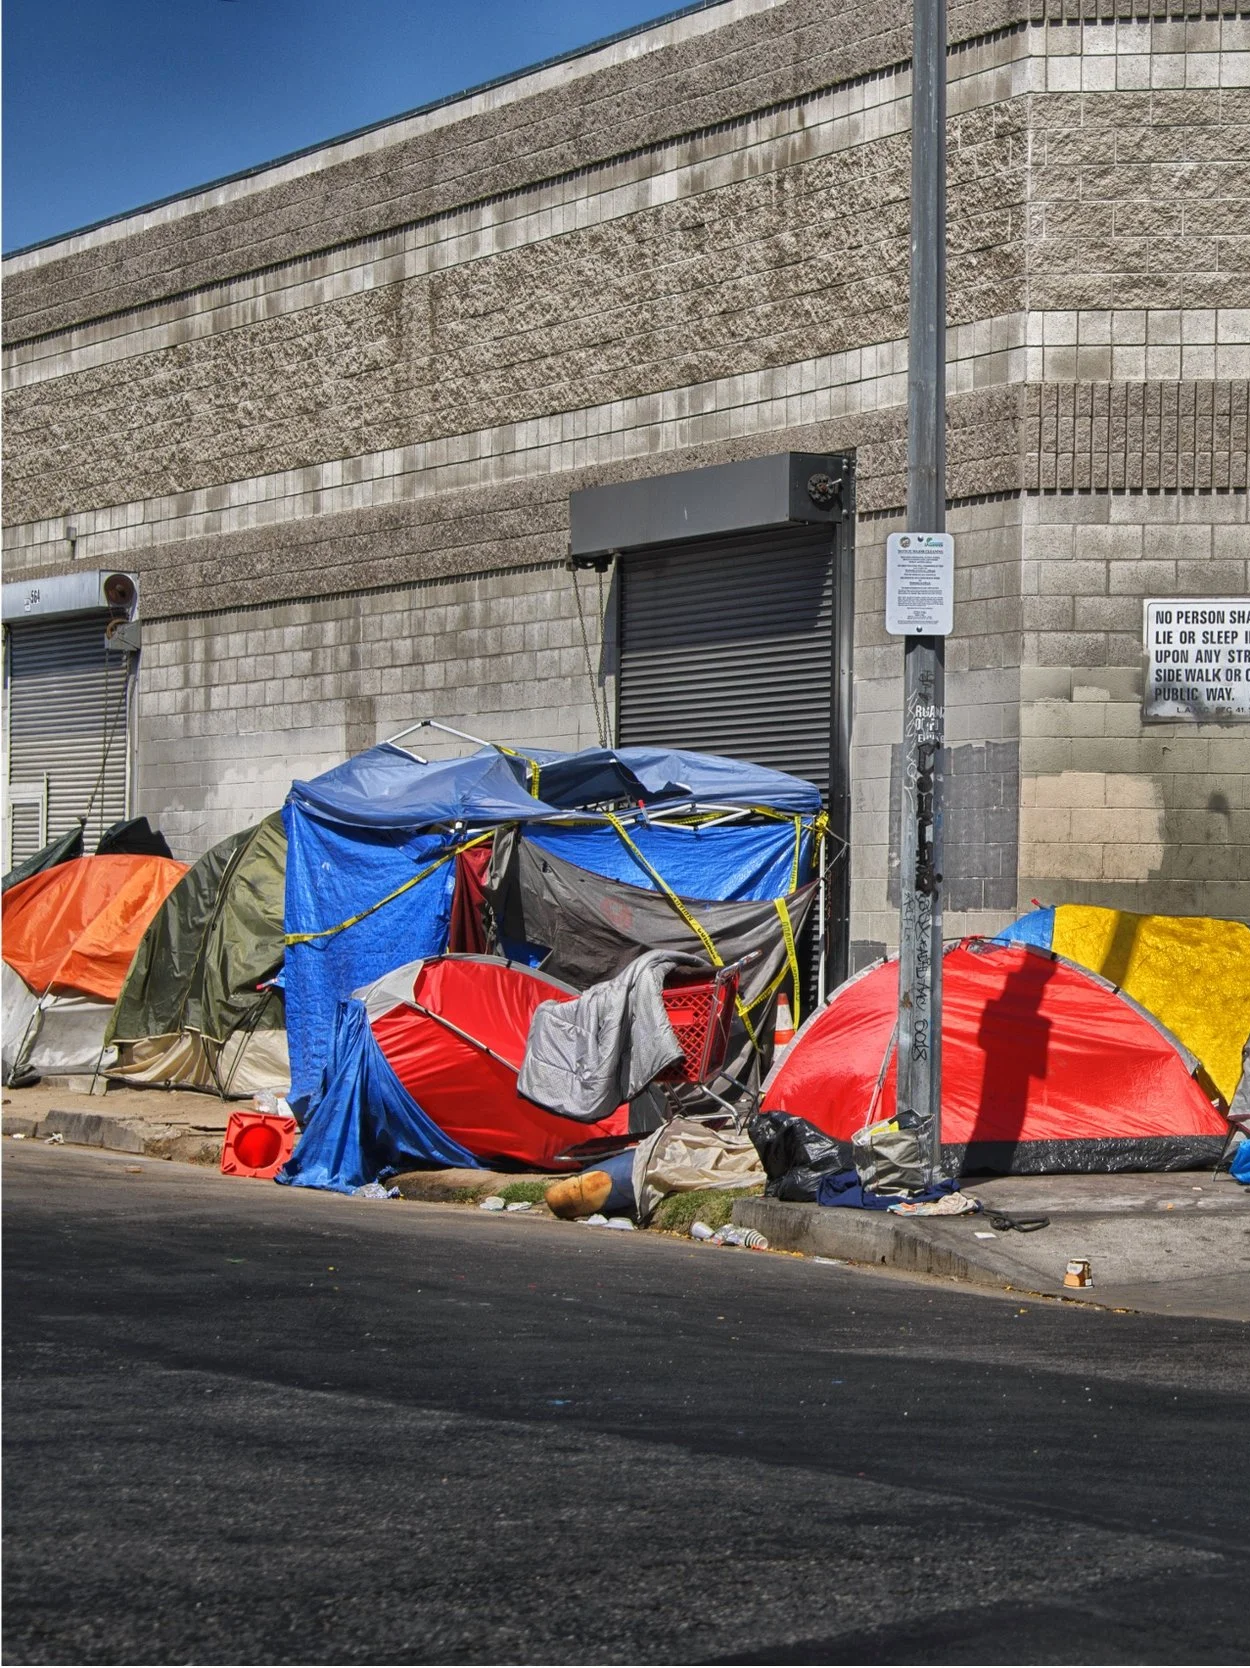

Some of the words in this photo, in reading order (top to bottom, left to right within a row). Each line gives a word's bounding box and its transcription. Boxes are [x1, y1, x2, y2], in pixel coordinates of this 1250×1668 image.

[1155, 611, 1172, 625] NO
[1176, 611, 1225, 625] PERSON
[1155, 631, 1173, 645] LIE
[1179, 631, 1196, 645] OR
[1202, 631, 1239, 645] SLEEP
[1155, 650, 1189, 663] UPON
[1195, 650, 1221, 663] ANY
[1155, 669, 1182, 682] SIDE
[1185, 669, 1221, 682] WALK
[1225, 669, 1241, 682] OR
[1155, 687, 1198, 701] PUBLIC
[1206, 687, 1235, 701] WAY.
